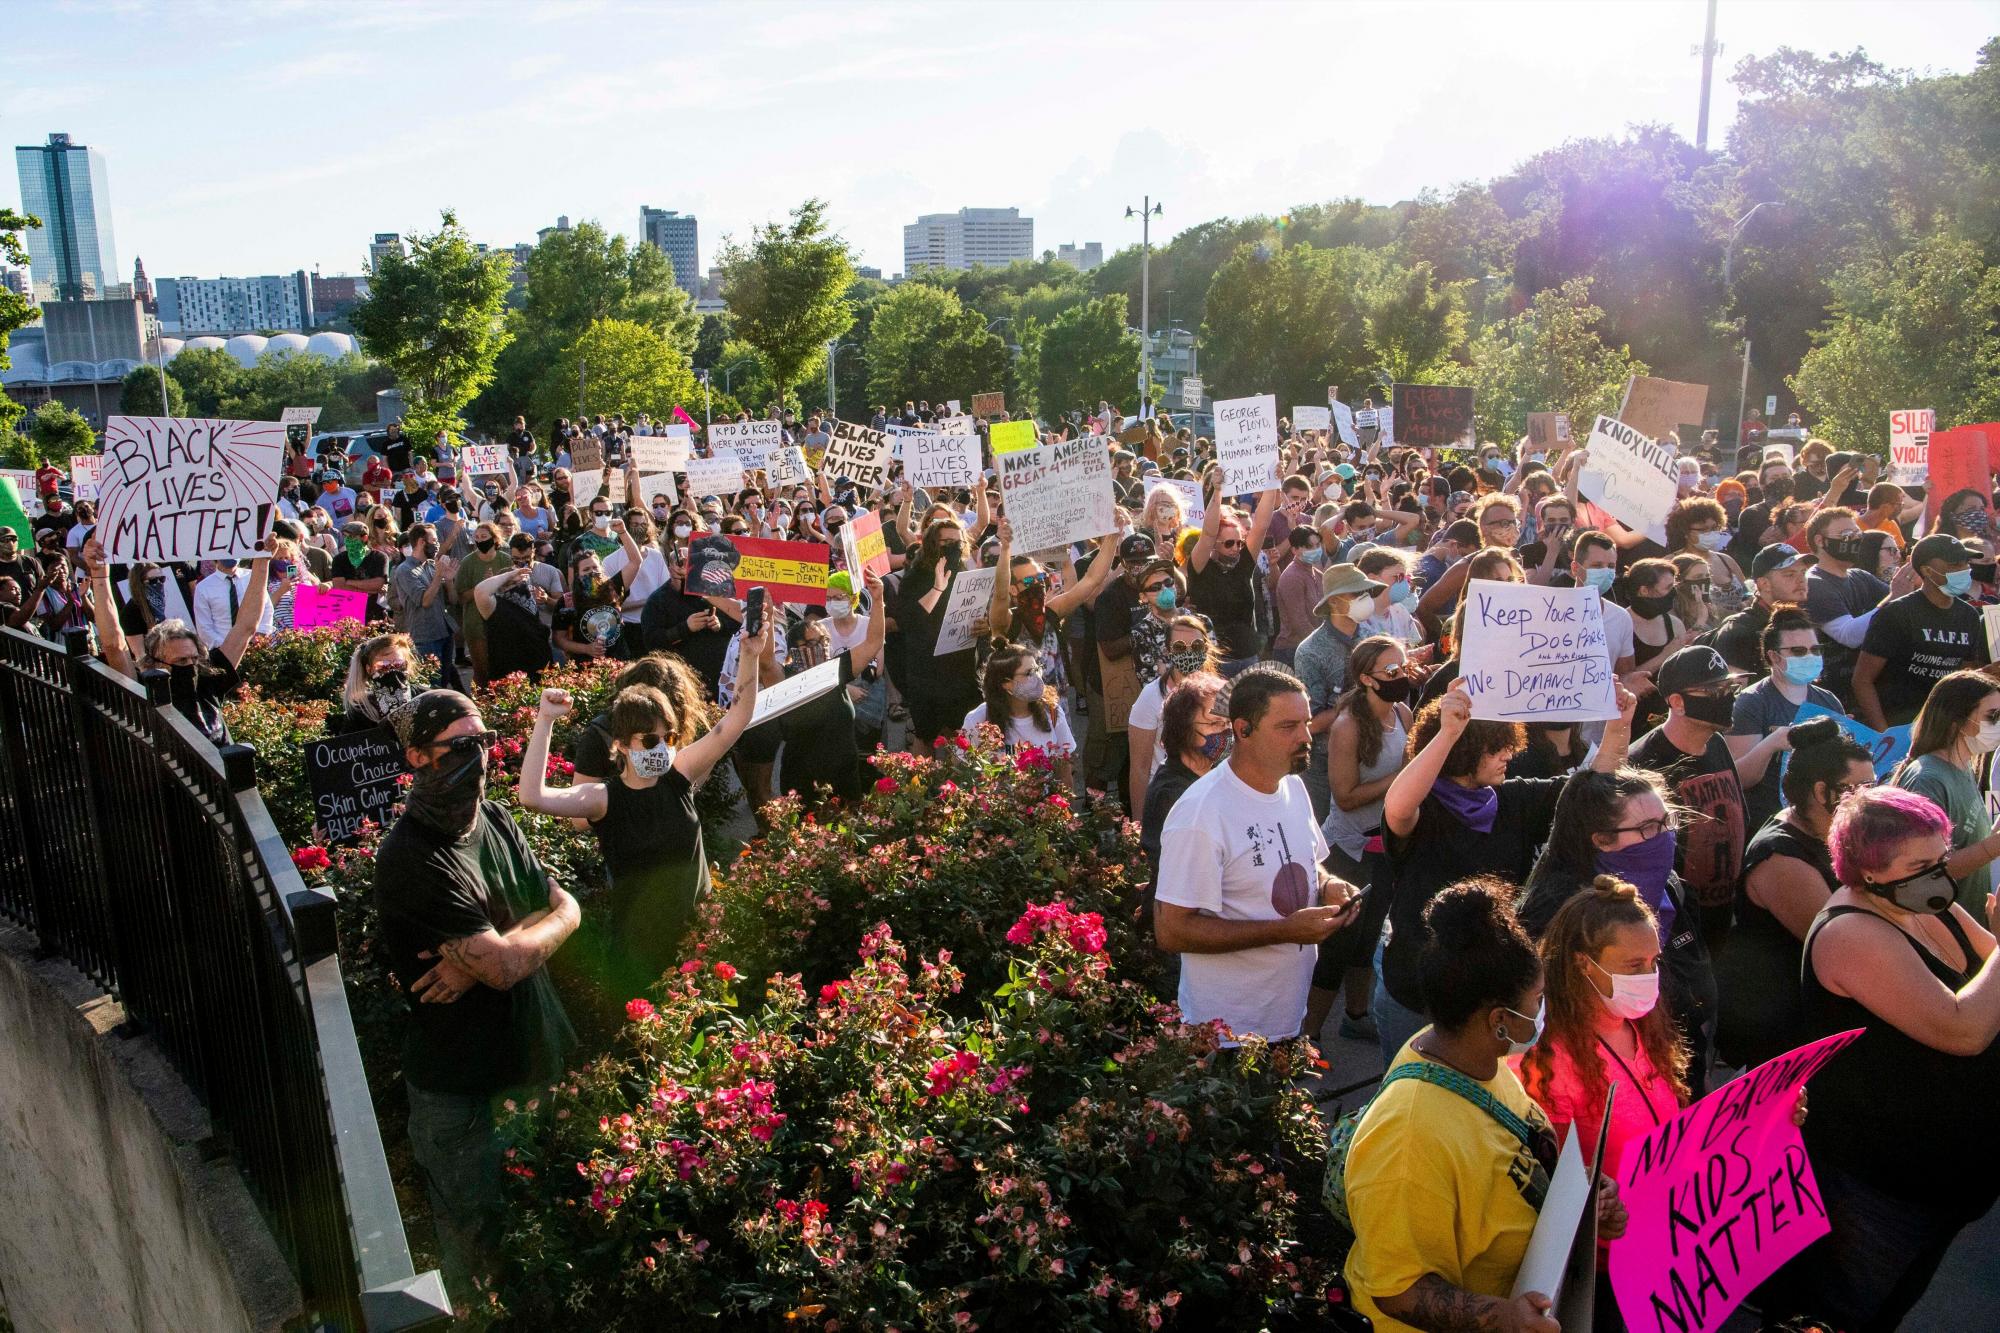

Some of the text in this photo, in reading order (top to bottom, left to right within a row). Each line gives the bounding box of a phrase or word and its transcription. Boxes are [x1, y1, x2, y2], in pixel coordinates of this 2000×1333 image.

[1184, 396, 1200, 405] ONLY
[1220, 406, 1261, 422] GEORGE
[715, 424, 778, 437] KPD & KCSO
[1238, 418, 1271, 434] FLOYD,
[734, 436, 779, 448] WATCHING
[834, 422, 886, 448] BLACK
[1238, 436, 1252, 445] WAS
[734, 447, 753, 456] YOU
[828, 439, 876, 462] LIVES
[918, 438, 966, 454] BLACK
[1220, 447, 1252, 461] HUMAN
[1597, 418, 1680, 484] KNOXVILLE
[112, 423, 232, 488] BLACK
[473, 455, 498, 464] LIVES
[768, 451, 781, 462] WE
[919, 456, 968, 471] LIVES
[1004, 452, 1041, 473] MAKE
[1053, 437, 1102, 462] AMERICA
[1892, 446, 1928, 465] VIOLE
[464, 462, 505, 473] MATTER
[822, 455, 883, 486] MATTER
[1003, 467, 1047, 490] GREAT
[1049, 463, 1060, 474] 4
[1060, 456, 1081, 471] THE
[1083, 463, 1107, 475] EVER
[1223, 463, 1266, 486] SAY HIS
[912, 470, 973, 486] MATTER
[145, 471, 227, 510] LIVES
[112, 502, 274, 561] MATTER!
[741, 556, 776, 570] POLICE
[799, 562, 824, 574] BLACK
[741, 566, 781, 582] BRUTALITY
[796, 571, 826, 585] DEATH
[956, 576, 995, 595] LIBERTY
[961, 595, 977, 608] AND
[947, 606, 983, 625] JUSTICE
[1478, 592, 1532, 636] Keep
[1524, 632, 1573, 650] DOG
[1911, 651, 1943, 666] YOUNG
[1908, 664, 1928, 677] FOR
[1465, 669, 1496, 697] We
[316, 738, 391, 768] Occupation
[351, 760, 401, 784] Choice
[318, 792, 357, 818] Skin
[360, 786, 392, 809] Color
[1629, 1034, 1859, 1188] MY BROWN
[1668, 1125, 1752, 1257] KIDS
[1649, 1144, 1826, 1333] MATTER
